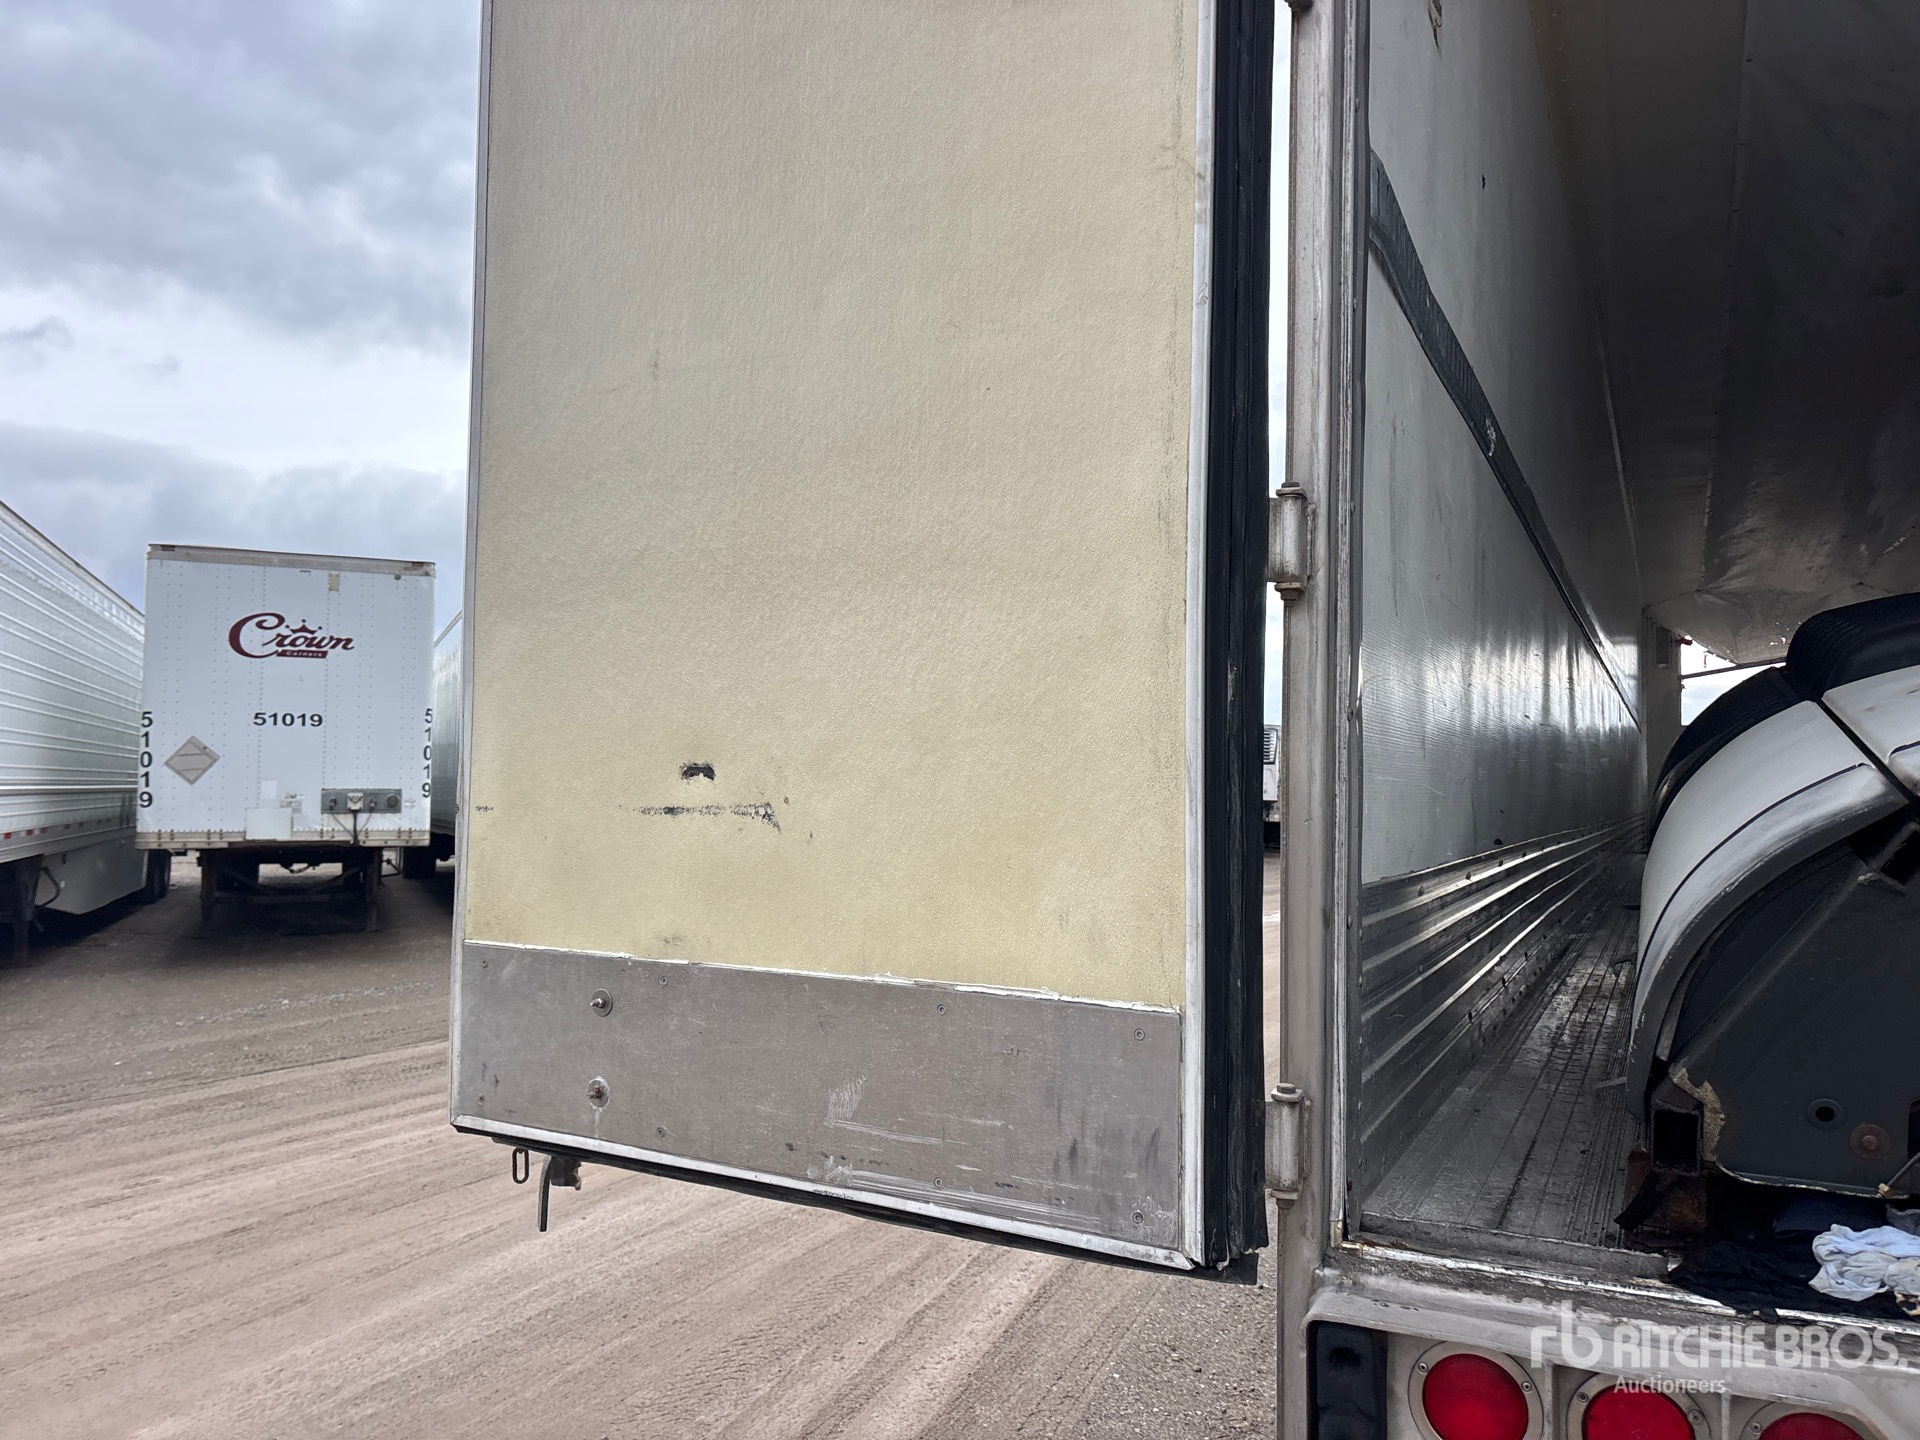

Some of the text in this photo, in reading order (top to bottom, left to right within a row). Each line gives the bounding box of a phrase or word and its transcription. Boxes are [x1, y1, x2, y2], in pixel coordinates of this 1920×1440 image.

[228, 612, 355, 659] Crown
[253, 712, 323, 728] 51019
[421, 708, 433, 798] 51019
[139, 711, 153, 808] 51019
